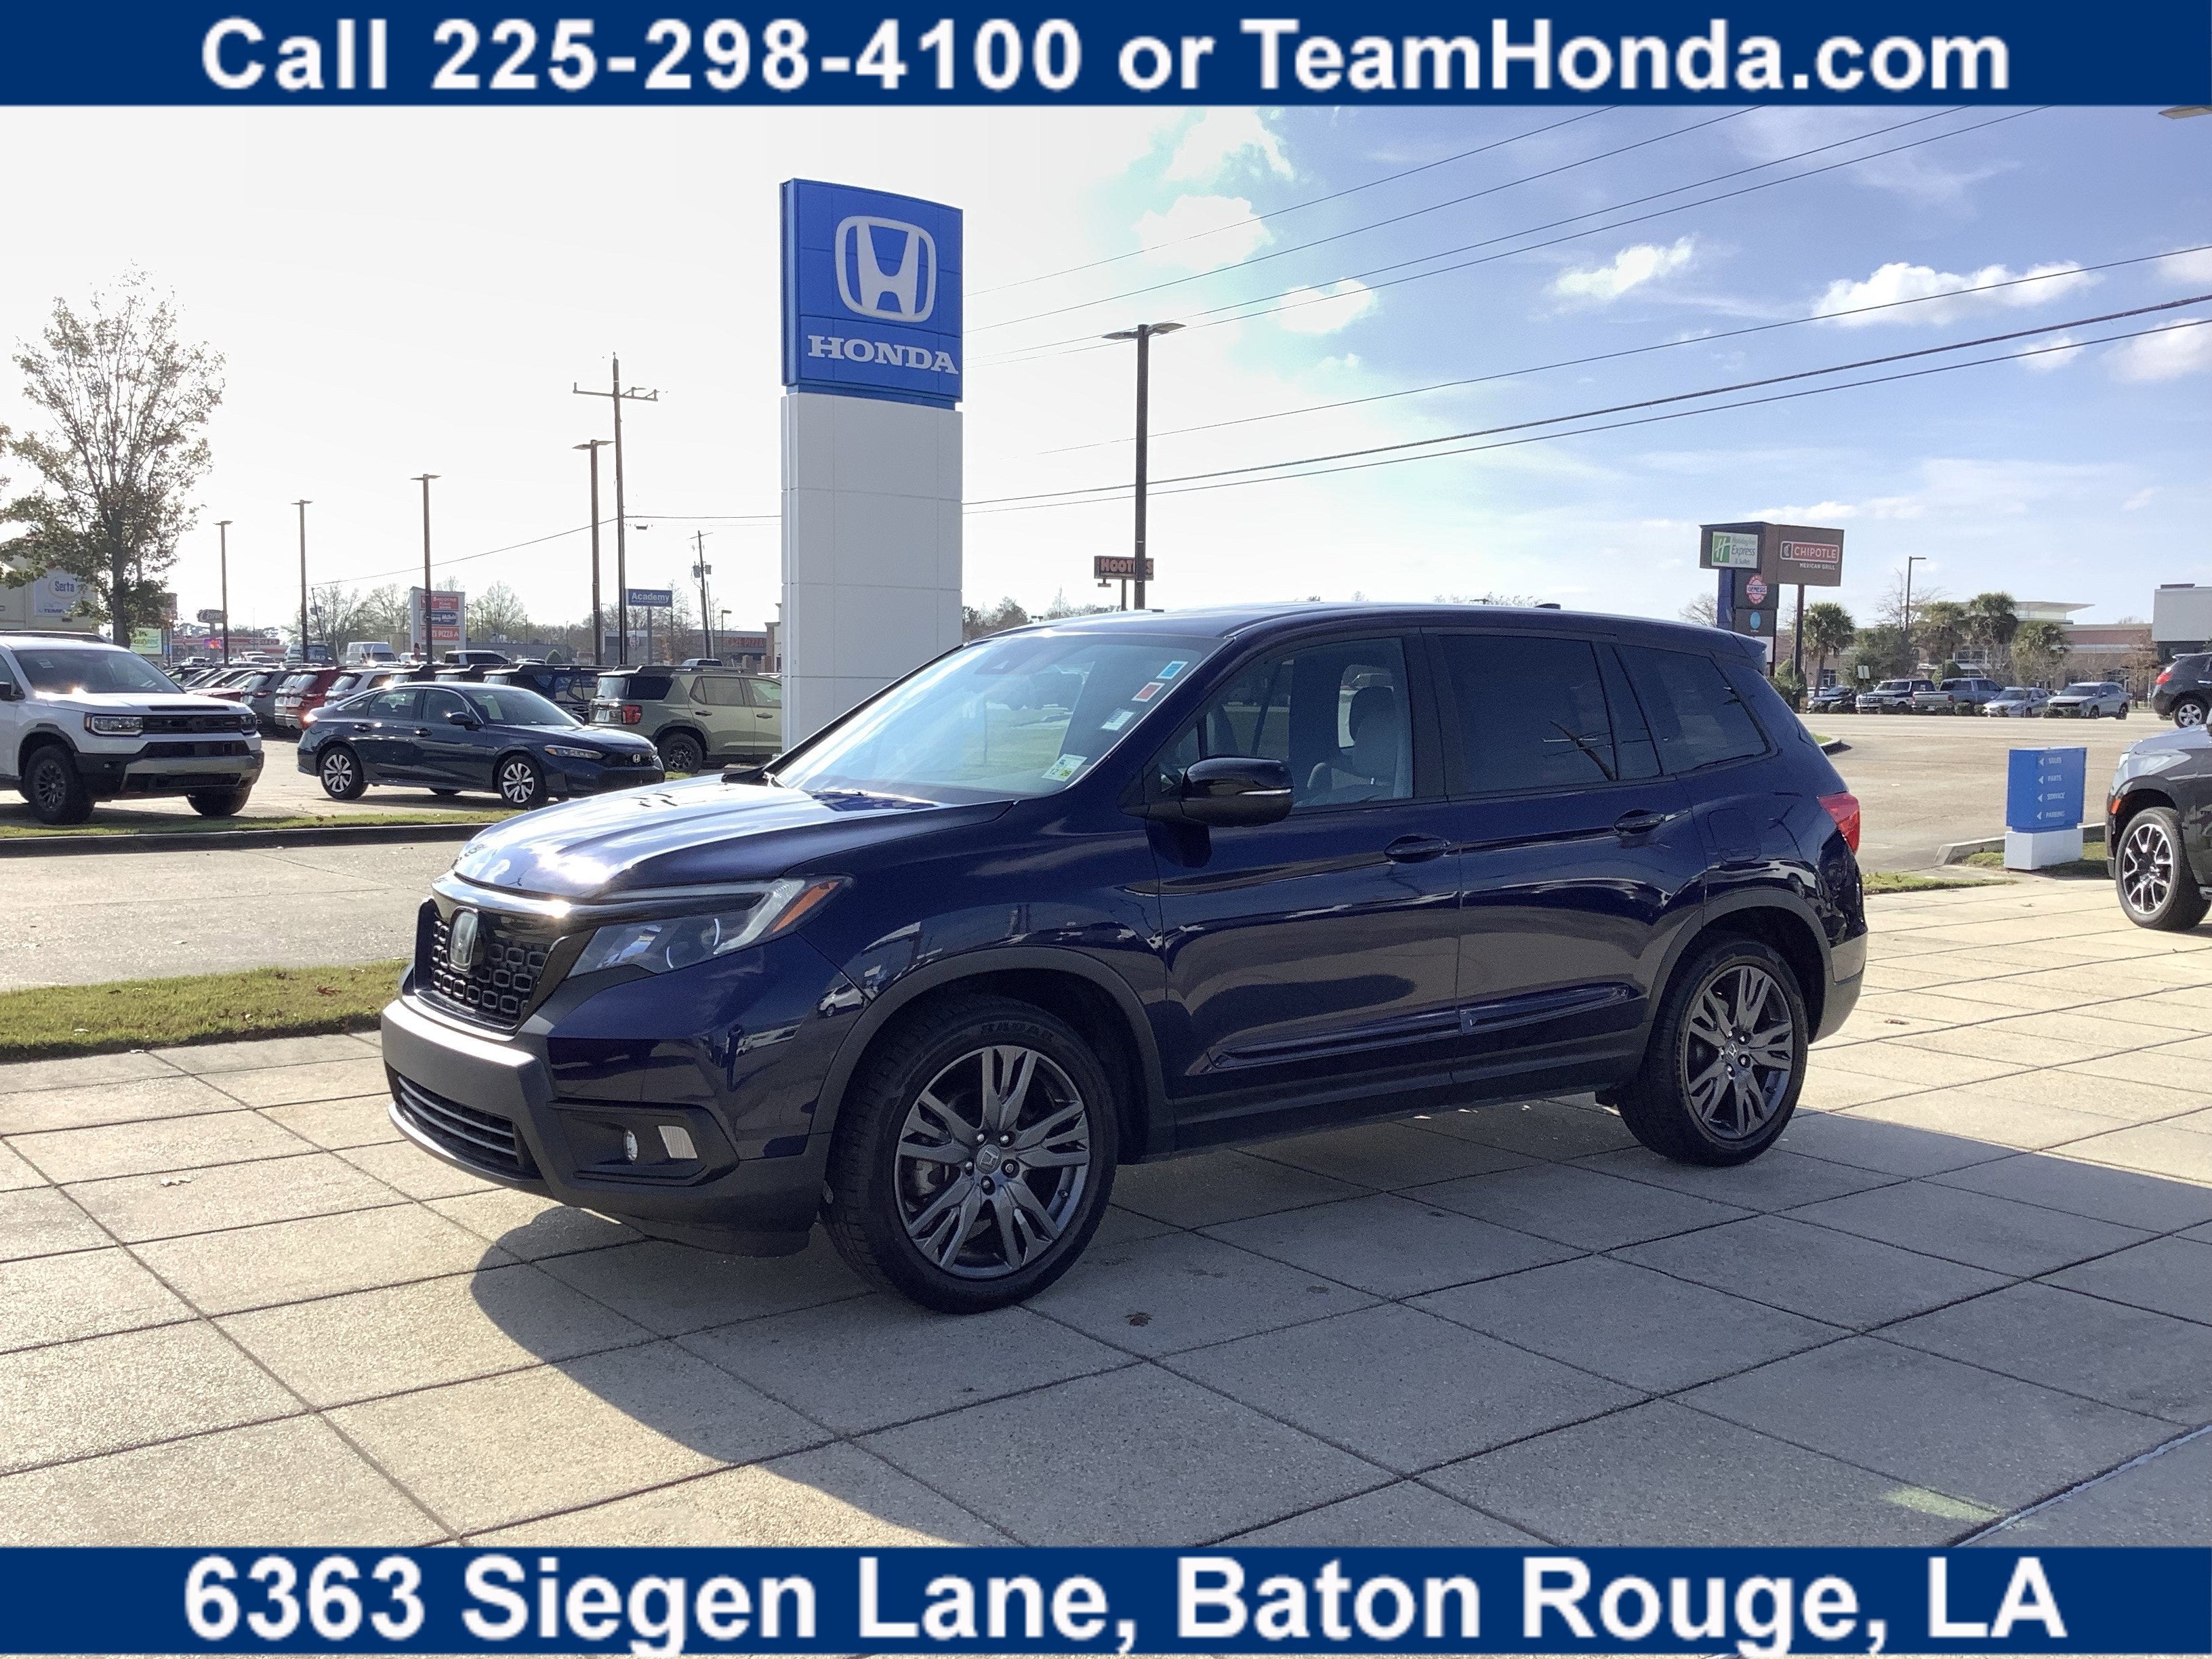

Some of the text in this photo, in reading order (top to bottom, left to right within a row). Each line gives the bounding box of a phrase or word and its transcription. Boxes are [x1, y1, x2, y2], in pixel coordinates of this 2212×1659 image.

[808, 335, 958, 375] HONDA
[1732, 544, 1755, 556] Express
[1794, 546, 1837, 558] CHIPOTLE
[1100, 557, 1153, 574] HOOTS
[55, 581, 75, 592] Serta
[631, 592, 670, 603] Academy
